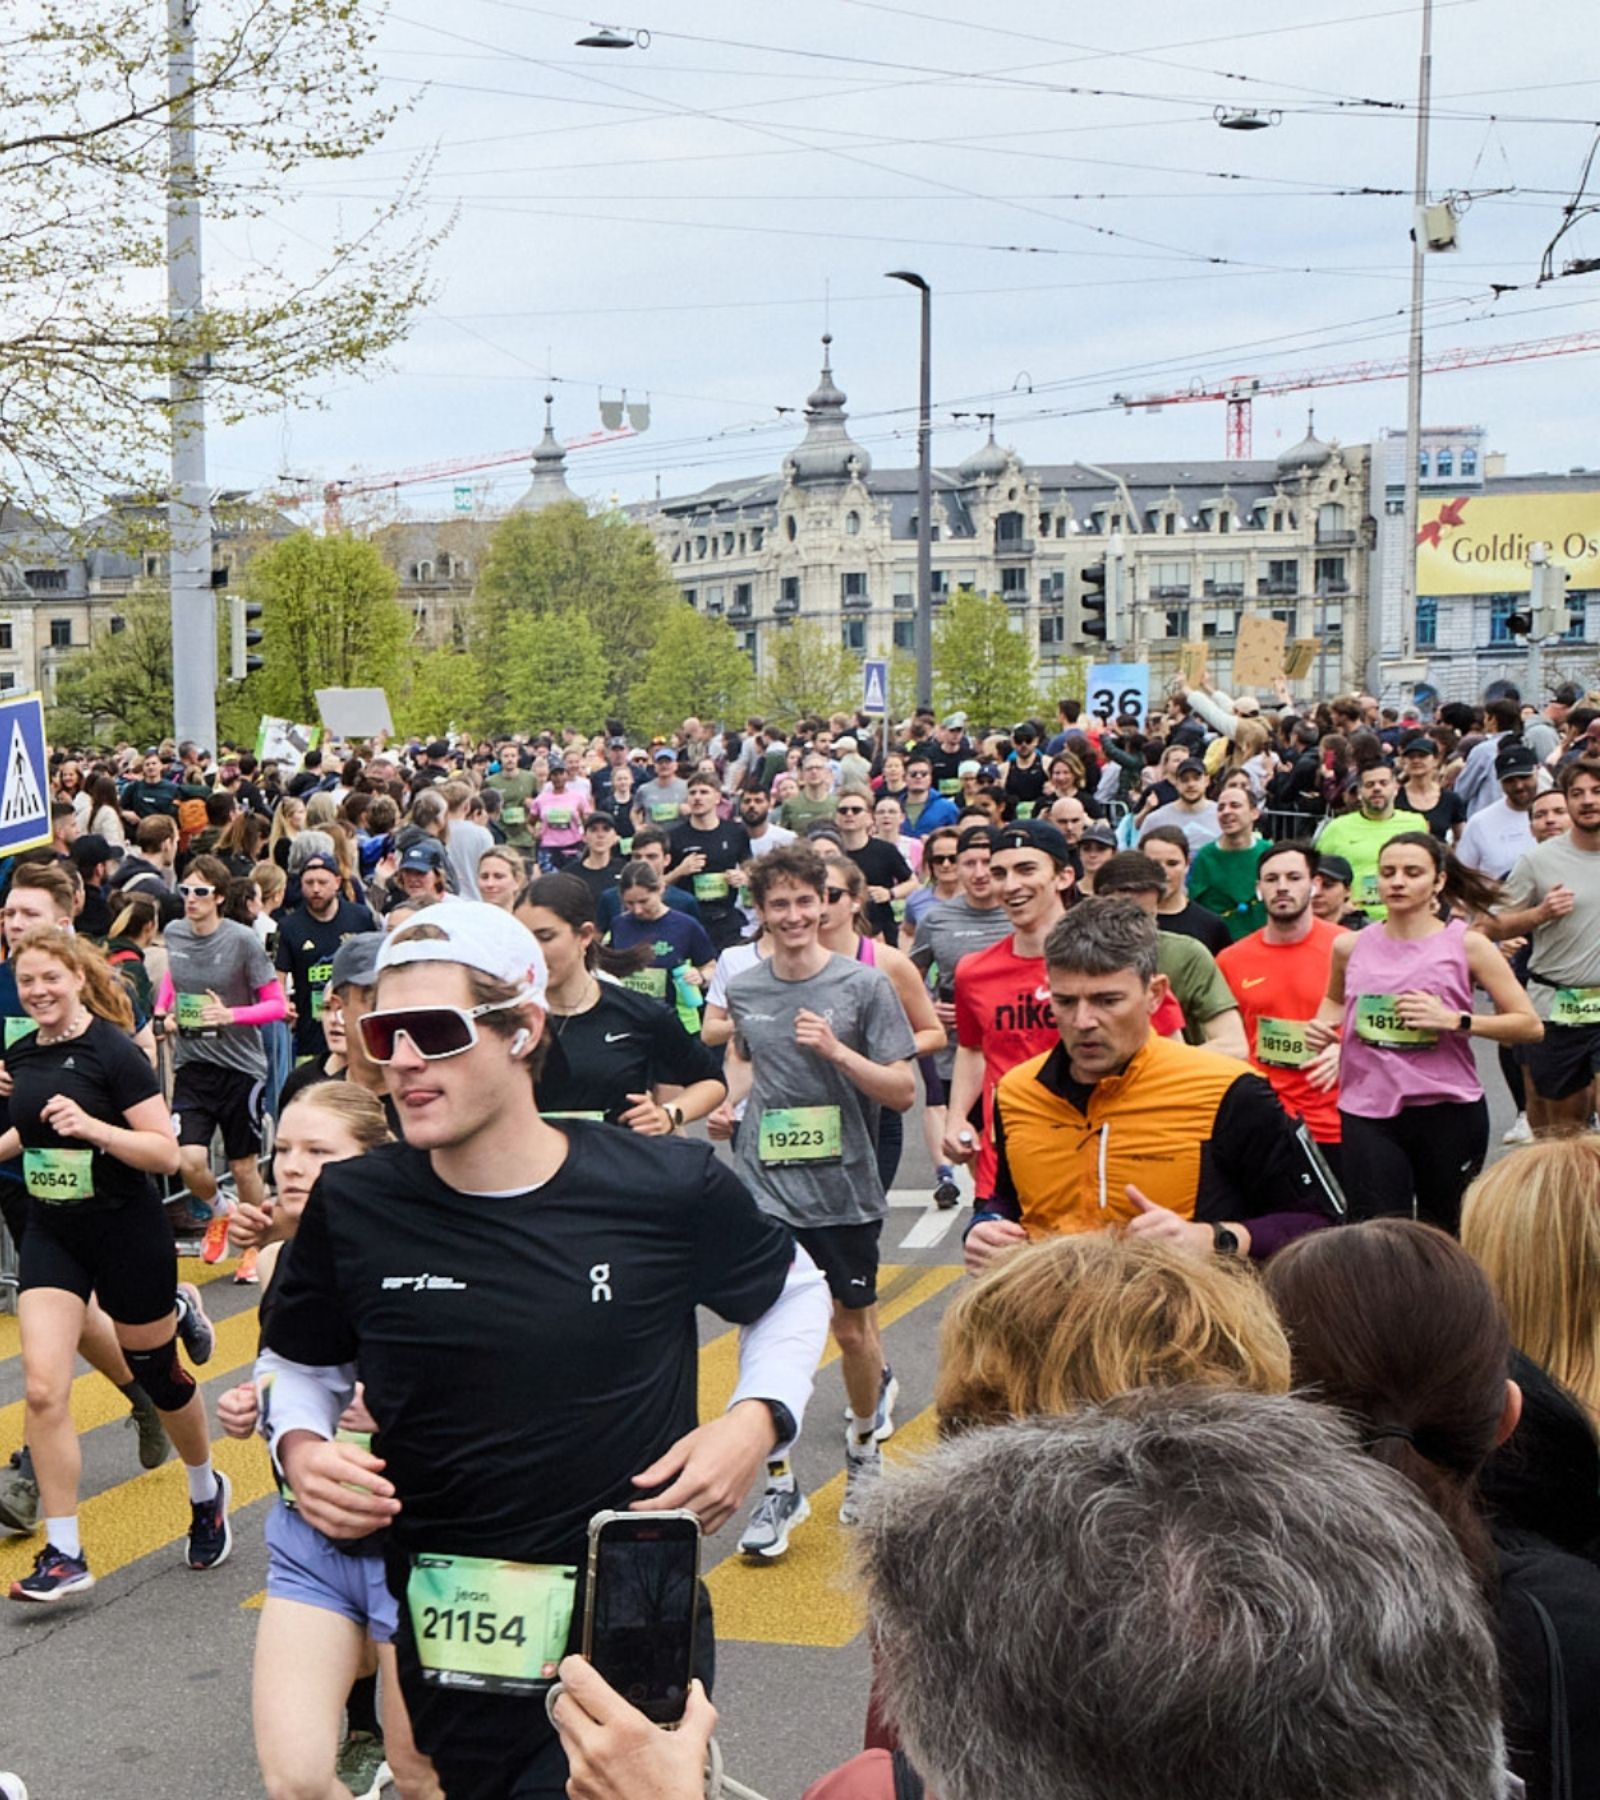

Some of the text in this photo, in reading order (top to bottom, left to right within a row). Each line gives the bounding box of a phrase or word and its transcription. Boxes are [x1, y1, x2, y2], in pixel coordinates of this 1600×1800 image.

[1091, 688, 1143, 718] 36
[767, 1130, 824, 1148] 19223
[29, 1170, 78, 1188] 20542
[454, 1586, 490, 1602] jean
[422, 1606, 527, 1647] 21154
